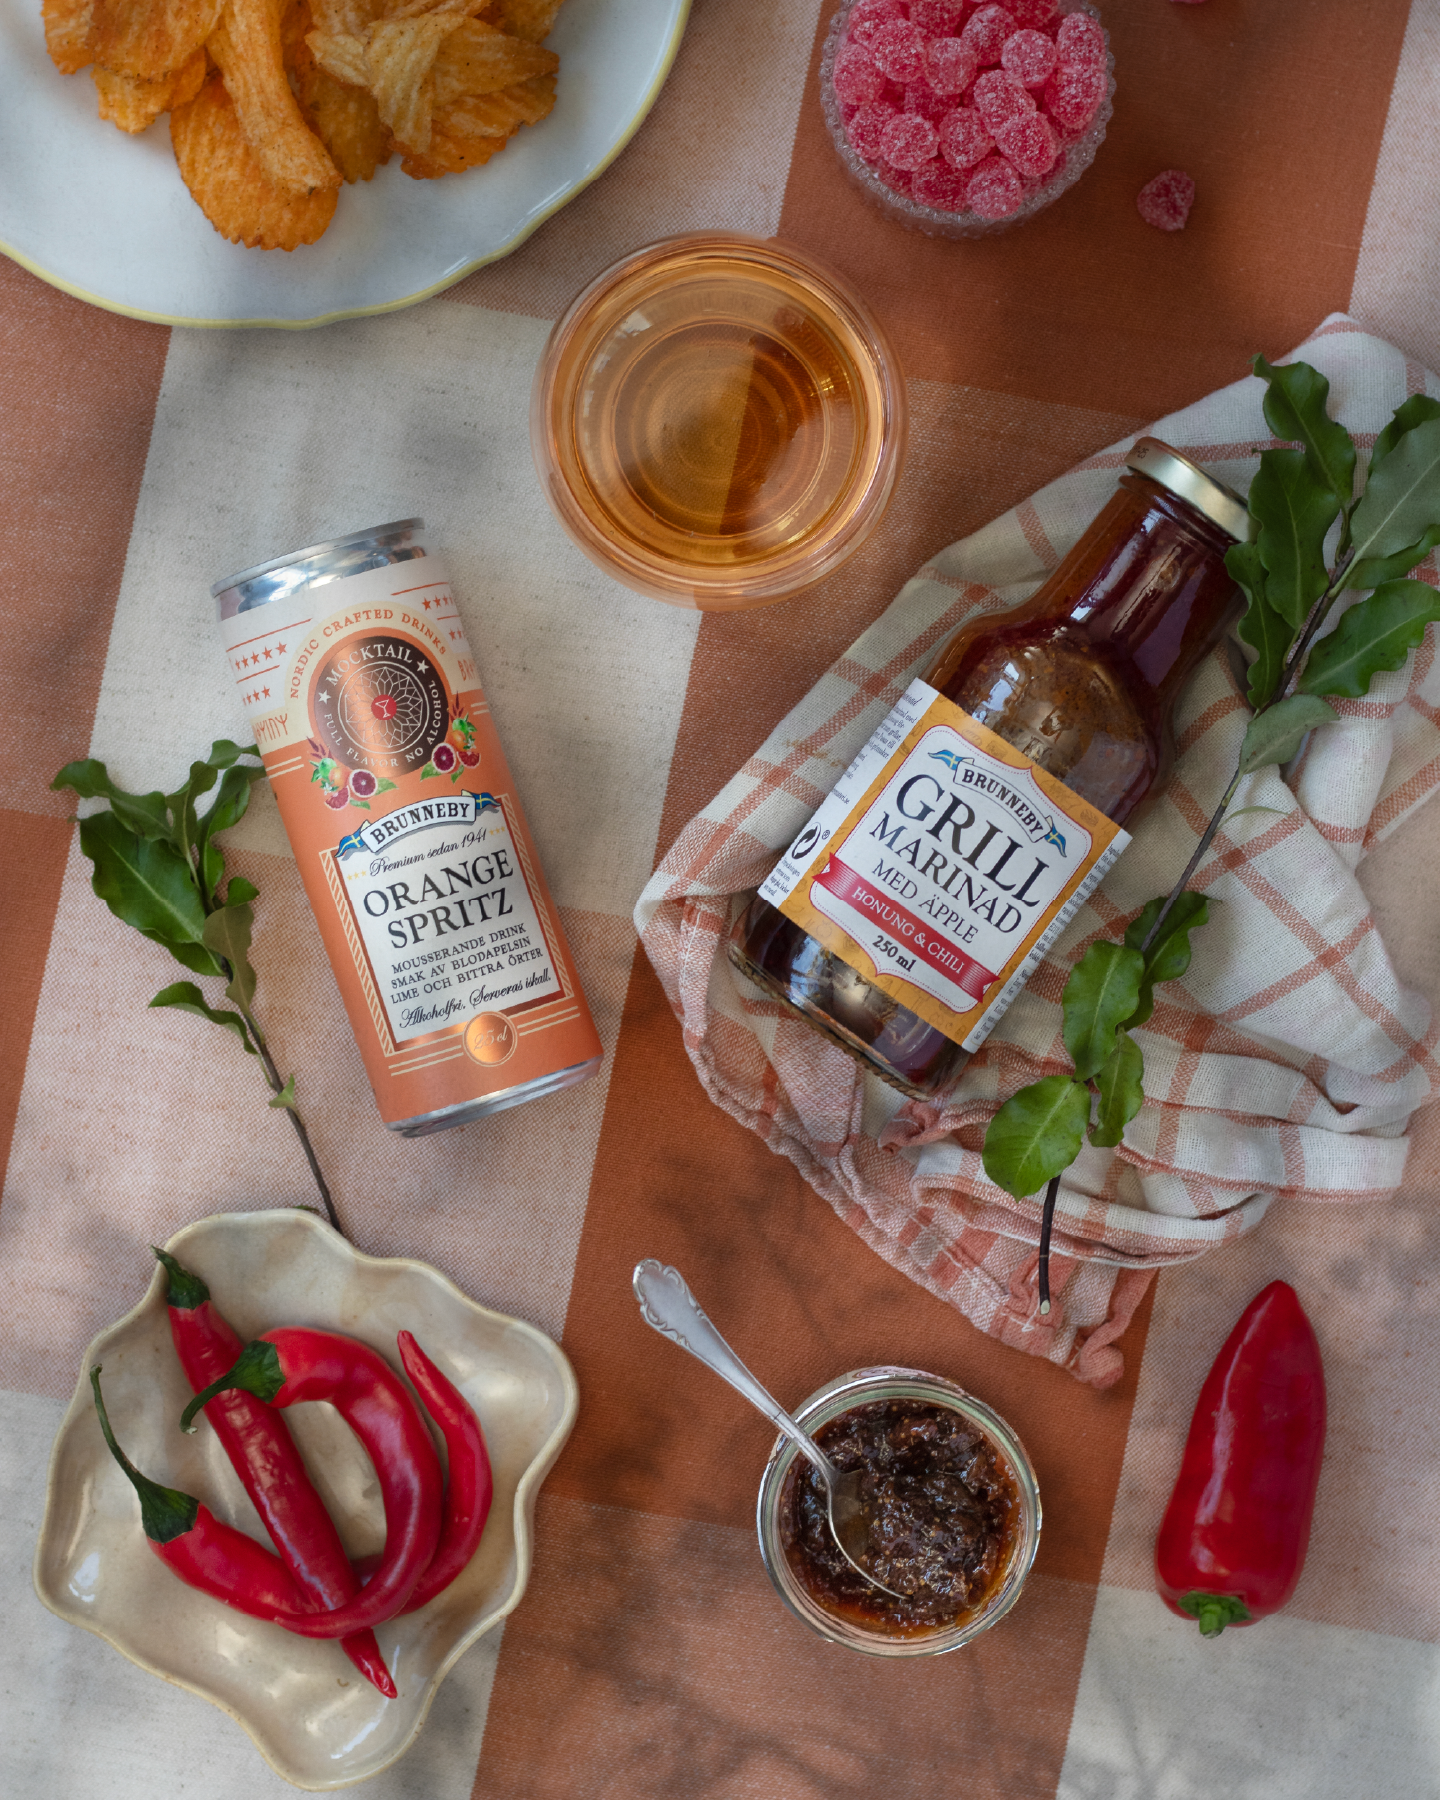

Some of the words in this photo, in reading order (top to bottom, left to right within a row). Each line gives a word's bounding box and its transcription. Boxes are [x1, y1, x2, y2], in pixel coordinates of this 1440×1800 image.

[290, 638, 320, 699] NORDIC
[323, 609, 394, 637] CRAFTED
[401, 612, 446, 655] DRINKS
[326, 643, 412, 687] MOCKTAIL
[324, 714, 341, 746] FULL
[346, 749, 399, 768] FLAVOR
[406, 748, 424, 762] NO
[427, 680, 442, 744] ALCOHOL
[370, 802, 470, 844] BRUNNEBY
[962, 768, 1043, 835] BRUNNEBY
[369, 853, 424, 877] Premium
[427, 843, 459, 859] sedan
[460, 828, 486, 848] 1941
[896, 774, 1049, 908] GRILL
[363, 849, 513, 917] ORANGE
[868, 811, 1021, 934] MARINAD
[871, 858, 918, 899] MED
[919, 894, 979, 943] ÄPPLE
[387, 888, 513, 949] SPRITZ
[852, 886, 915, 937] HONUNG
[913, 932, 925, 948] &
[927, 942, 964, 974] CHILI
[390, 987, 420, 1004] LIME
[426, 978, 452, 994] OCH
[458, 962, 505, 983] BITTRA
[508, 948, 543, 967] ÖRTER
[391, 936, 486, 975] MOUSSERANDE
[489, 923, 526, 944] DRINK
[391, 969, 426, 989] SMAK
[430, 964, 447, 978] AV
[452, 937, 531, 970] BLODAPELSIN
[873, 935, 897, 958] 250
[897, 953, 916, 972] ml
[399, 998, 465, 1028] Alkoholfri.
[469, 982, 523, 1008] Serveras
[524, 968, 551, 991] iskall.
[473, 1028, 494, 1051] 25
[494, 1025, 508, 1042] cl
